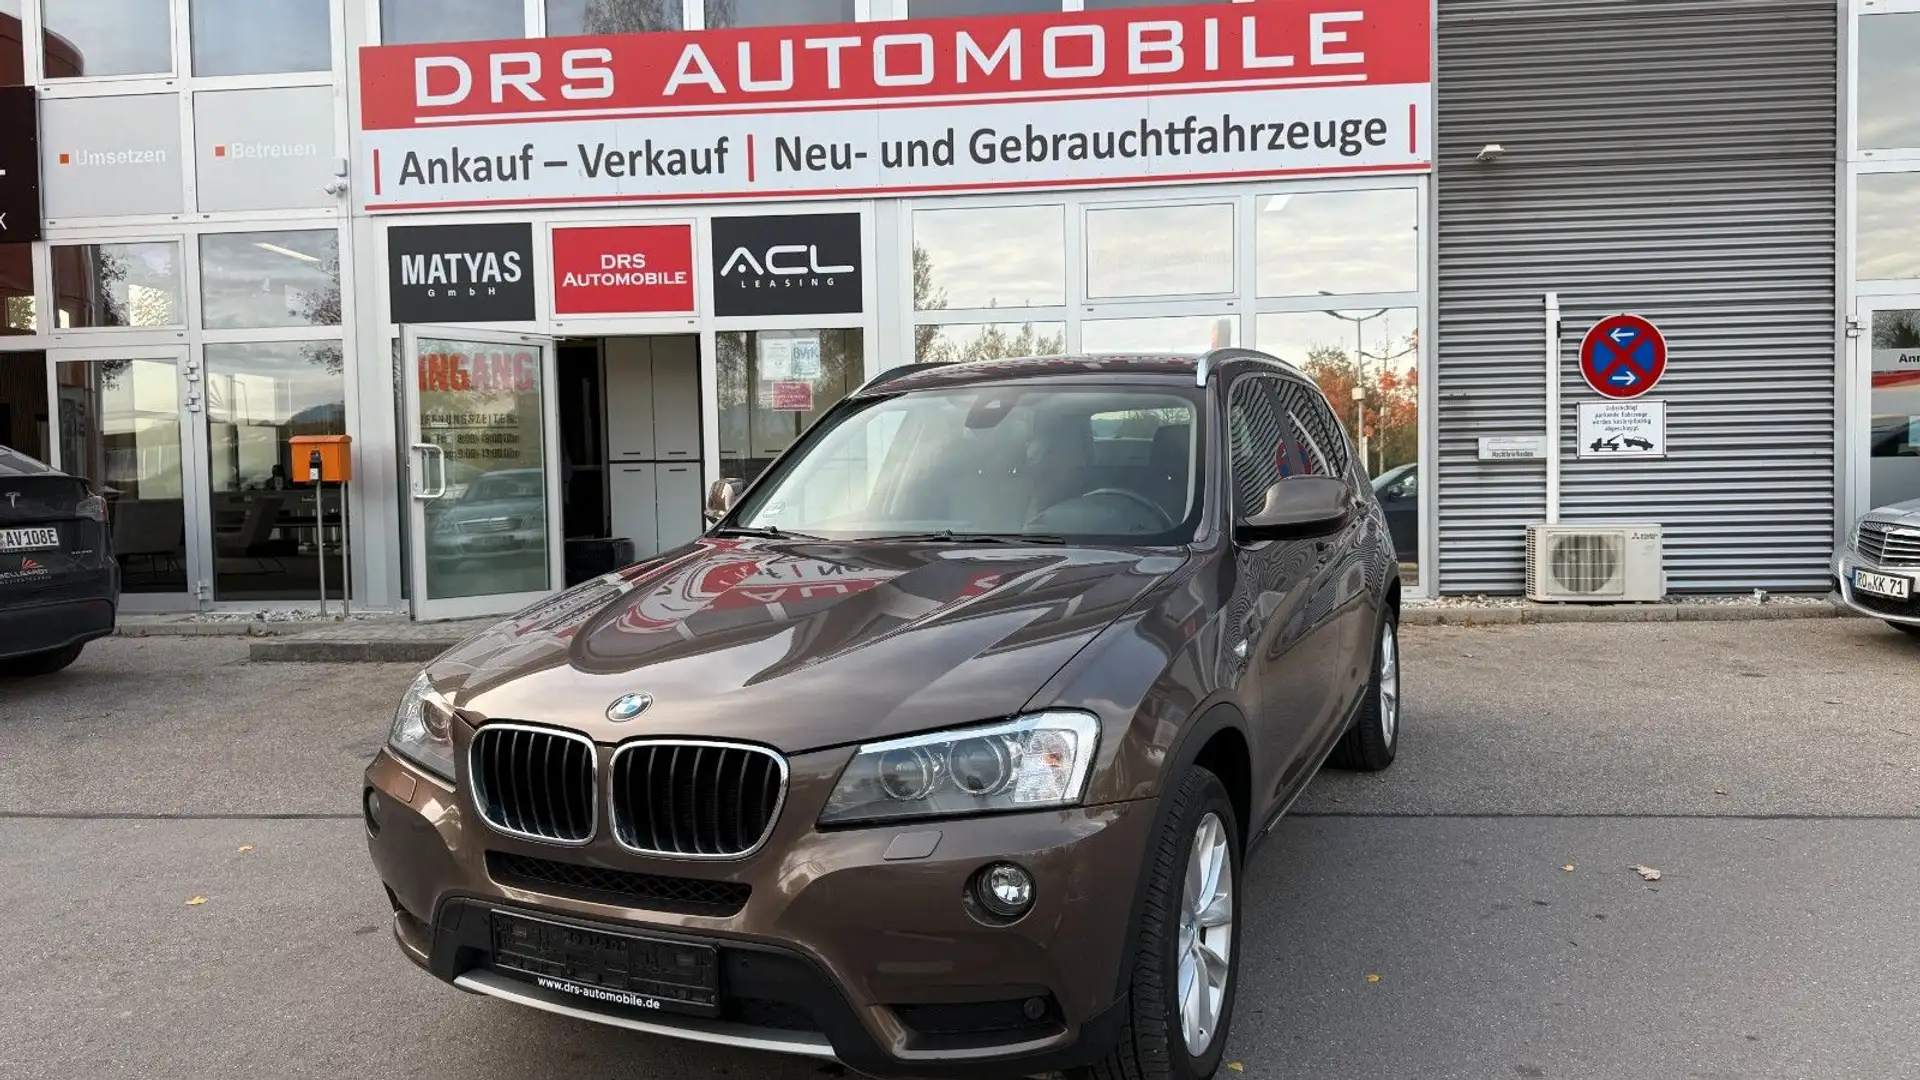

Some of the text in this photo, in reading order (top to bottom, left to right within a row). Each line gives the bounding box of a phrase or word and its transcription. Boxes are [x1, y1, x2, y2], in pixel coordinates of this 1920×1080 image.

[414, 10, 1365, 107] DRS AUTOMOBILE
[76, 148, 166, 166] Umsetzen
[231, 142, 316, 159] Betreuen
[399, 143, 533, 186] Ankauf
[577, 135, 729, 179] Verkauf
[775, 136, 867, 172] Neu-
[881, 127, 954, 168] und
[969, 114, 1387, 166] Gebrauchtfahrzeuge
[401, 250, 522, 285] MATYAS
[601, 253, 646, 269] DRS
[720, 244, 855, 277] ACL
[562, 271, 687, 287] AUTOMOBILE
[741, 278, 834, 288] LEASING
[1873, 576, 1886, 592] KK
[1890, 579, 1904, 596] 71
[537, 976, 661, 1010] www.drs-automobile.de
